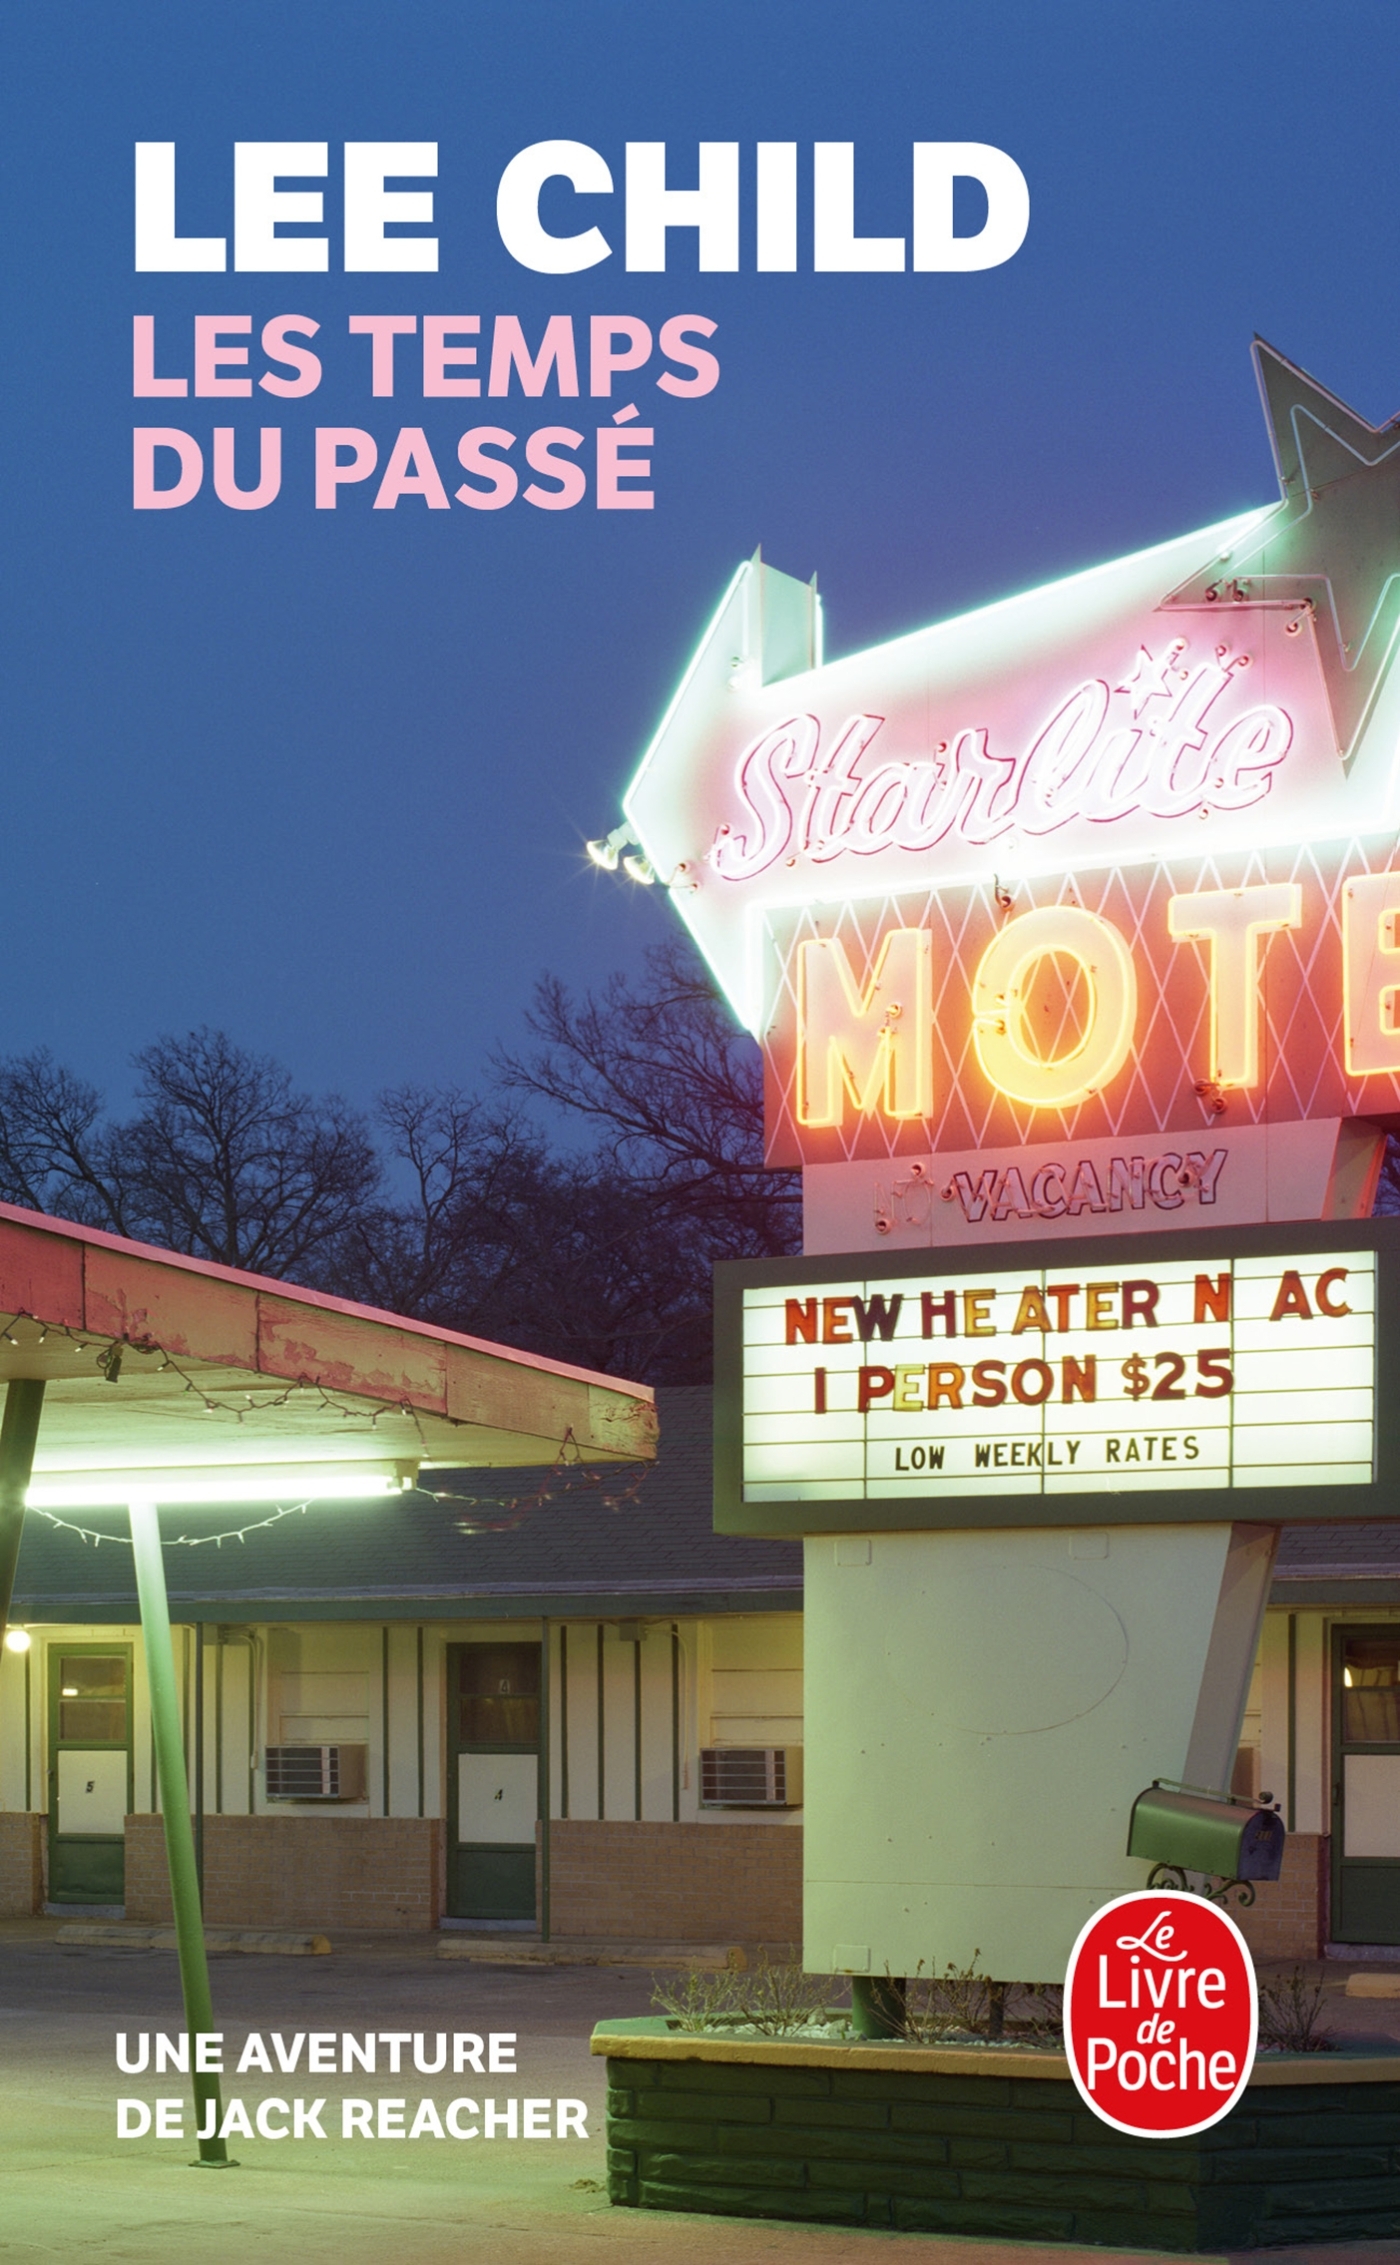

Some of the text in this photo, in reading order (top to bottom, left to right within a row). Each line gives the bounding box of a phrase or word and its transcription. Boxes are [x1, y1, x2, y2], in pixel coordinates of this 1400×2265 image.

[709, 646, 1294, 881] Starlite
[954, 1149, 1228, 1223] VACANCY
[785, 1293, 903, 1345] NEW
[1269, 1267, 1353, 1322] AC
[858, 1354, 1097, 1414] PERSON
[1120, 1347, 1234, 1401] $25
[895, 1434, 1201, 1472] LOW WEEKLY RATES
[86, 1780, 95, 1793] 5
